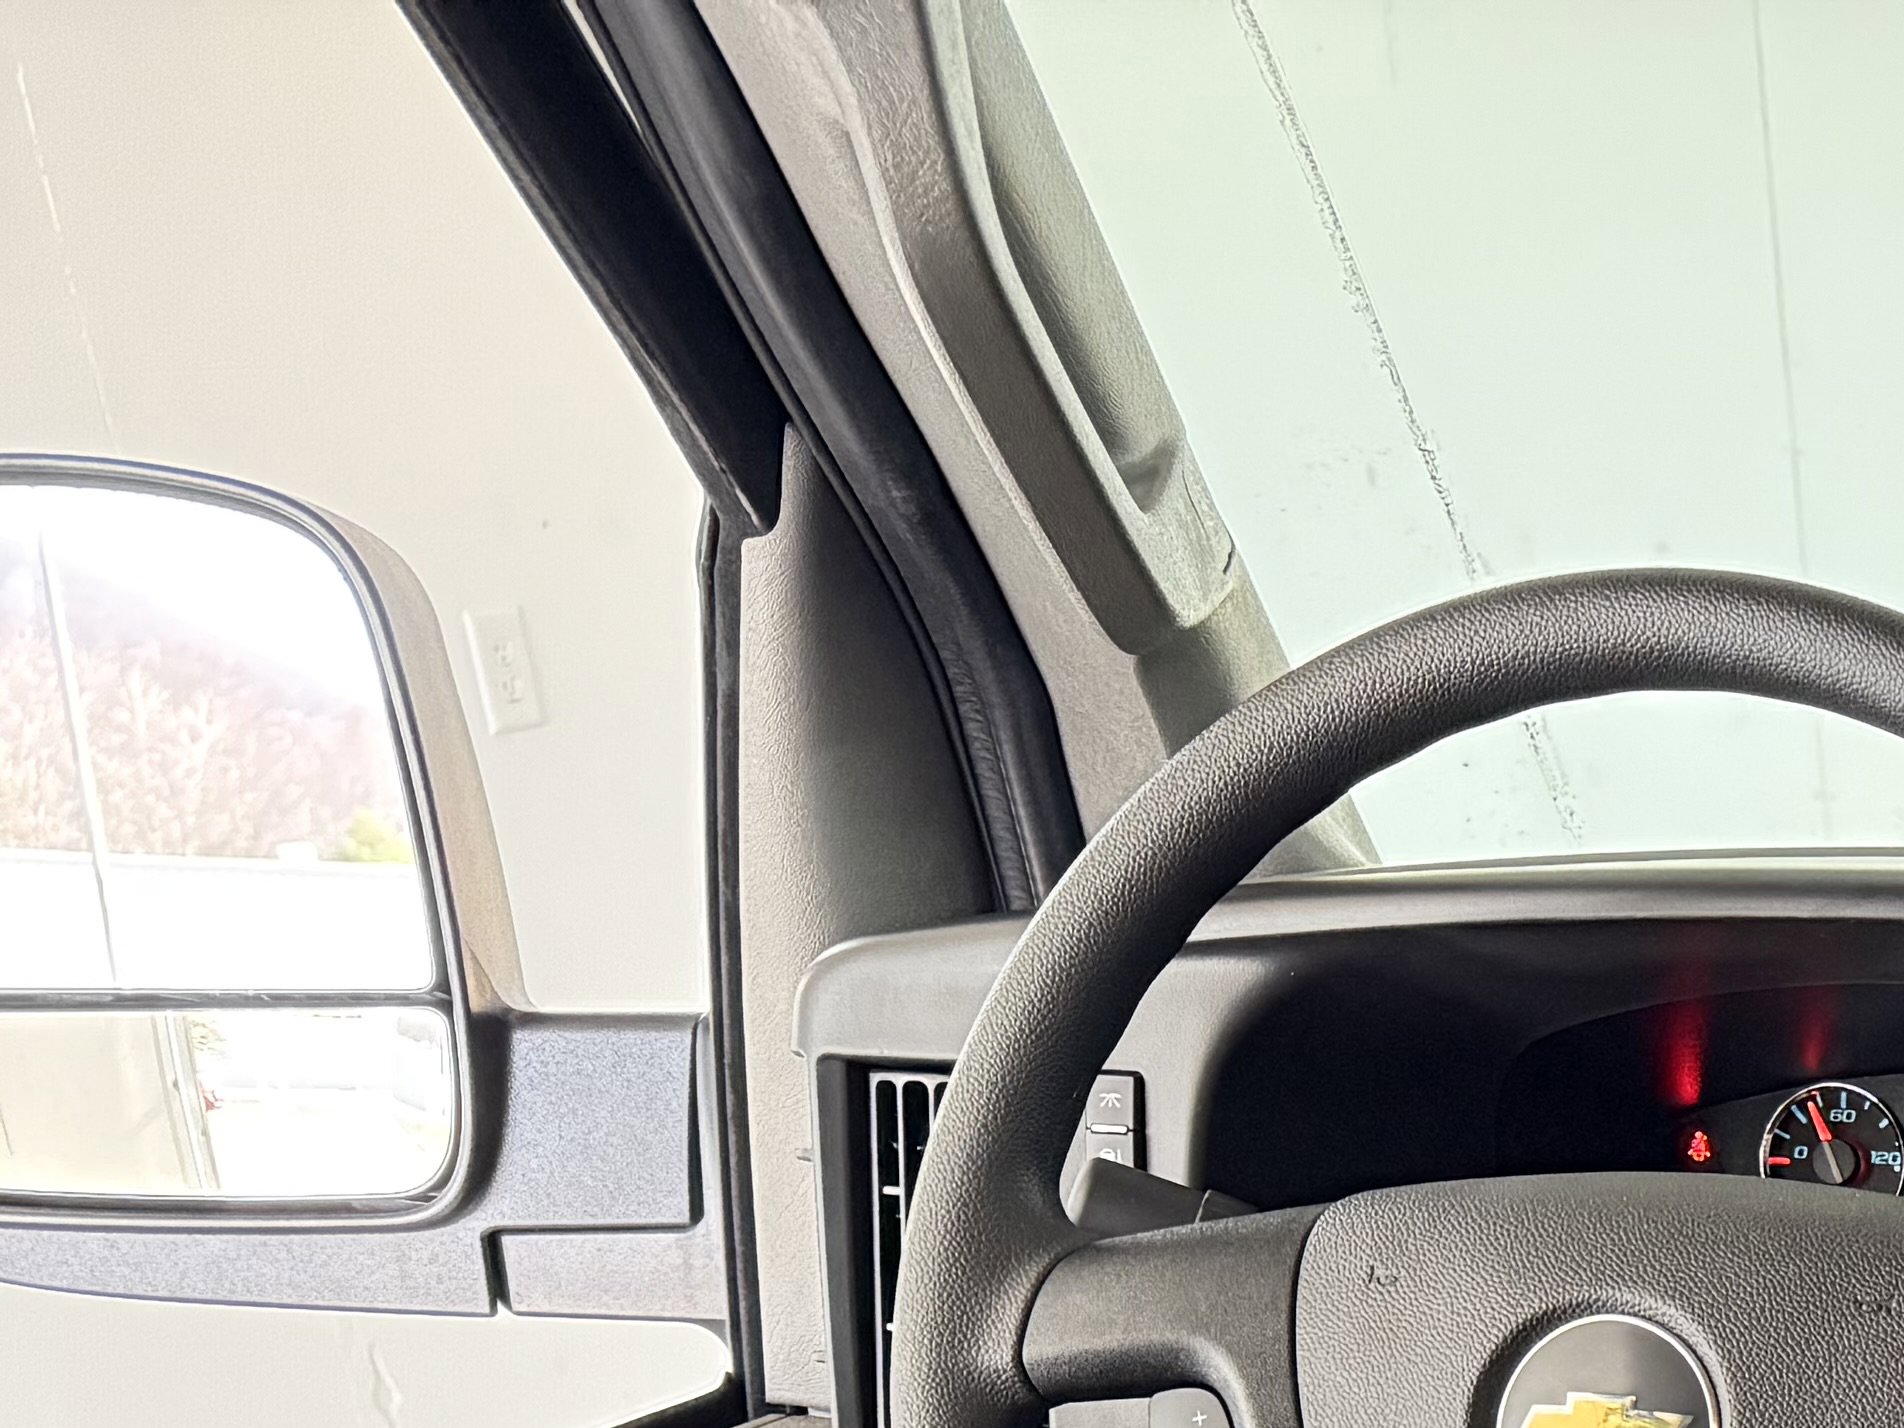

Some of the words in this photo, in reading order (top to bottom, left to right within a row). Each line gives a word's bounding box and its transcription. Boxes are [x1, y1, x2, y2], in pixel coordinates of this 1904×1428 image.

[1830, 1110, 1856, 1123] 60
[1794, 1146, 1808, 1159] 0
[1871, 1151, 1901, 1165] 120
